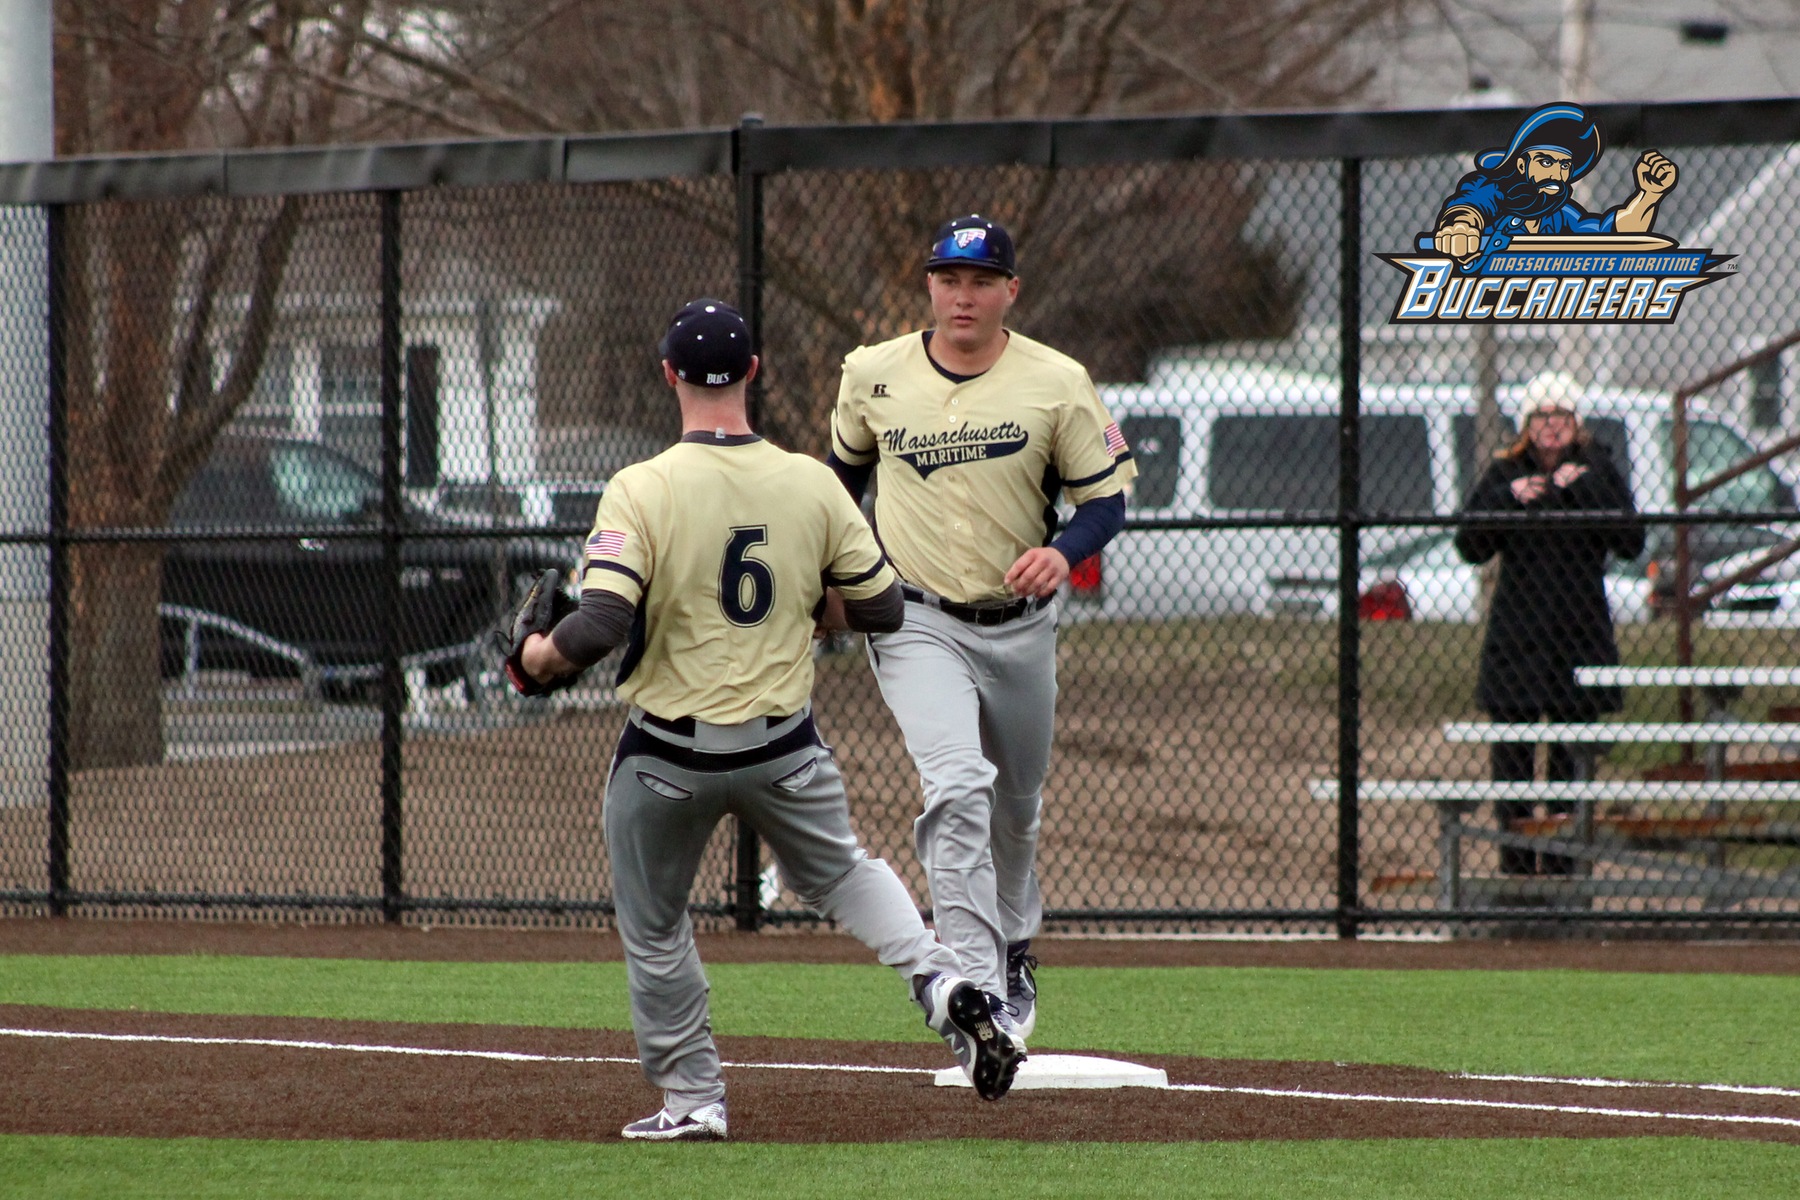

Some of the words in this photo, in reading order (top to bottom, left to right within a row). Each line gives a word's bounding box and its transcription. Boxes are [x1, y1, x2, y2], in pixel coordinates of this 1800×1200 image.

[706, 372, 730, 384] BUCS
[883, 421, 1023, 452] Massachusetts
[915, 445, 987, 468] MARITIME
[717, 524, 776, 628] 6
